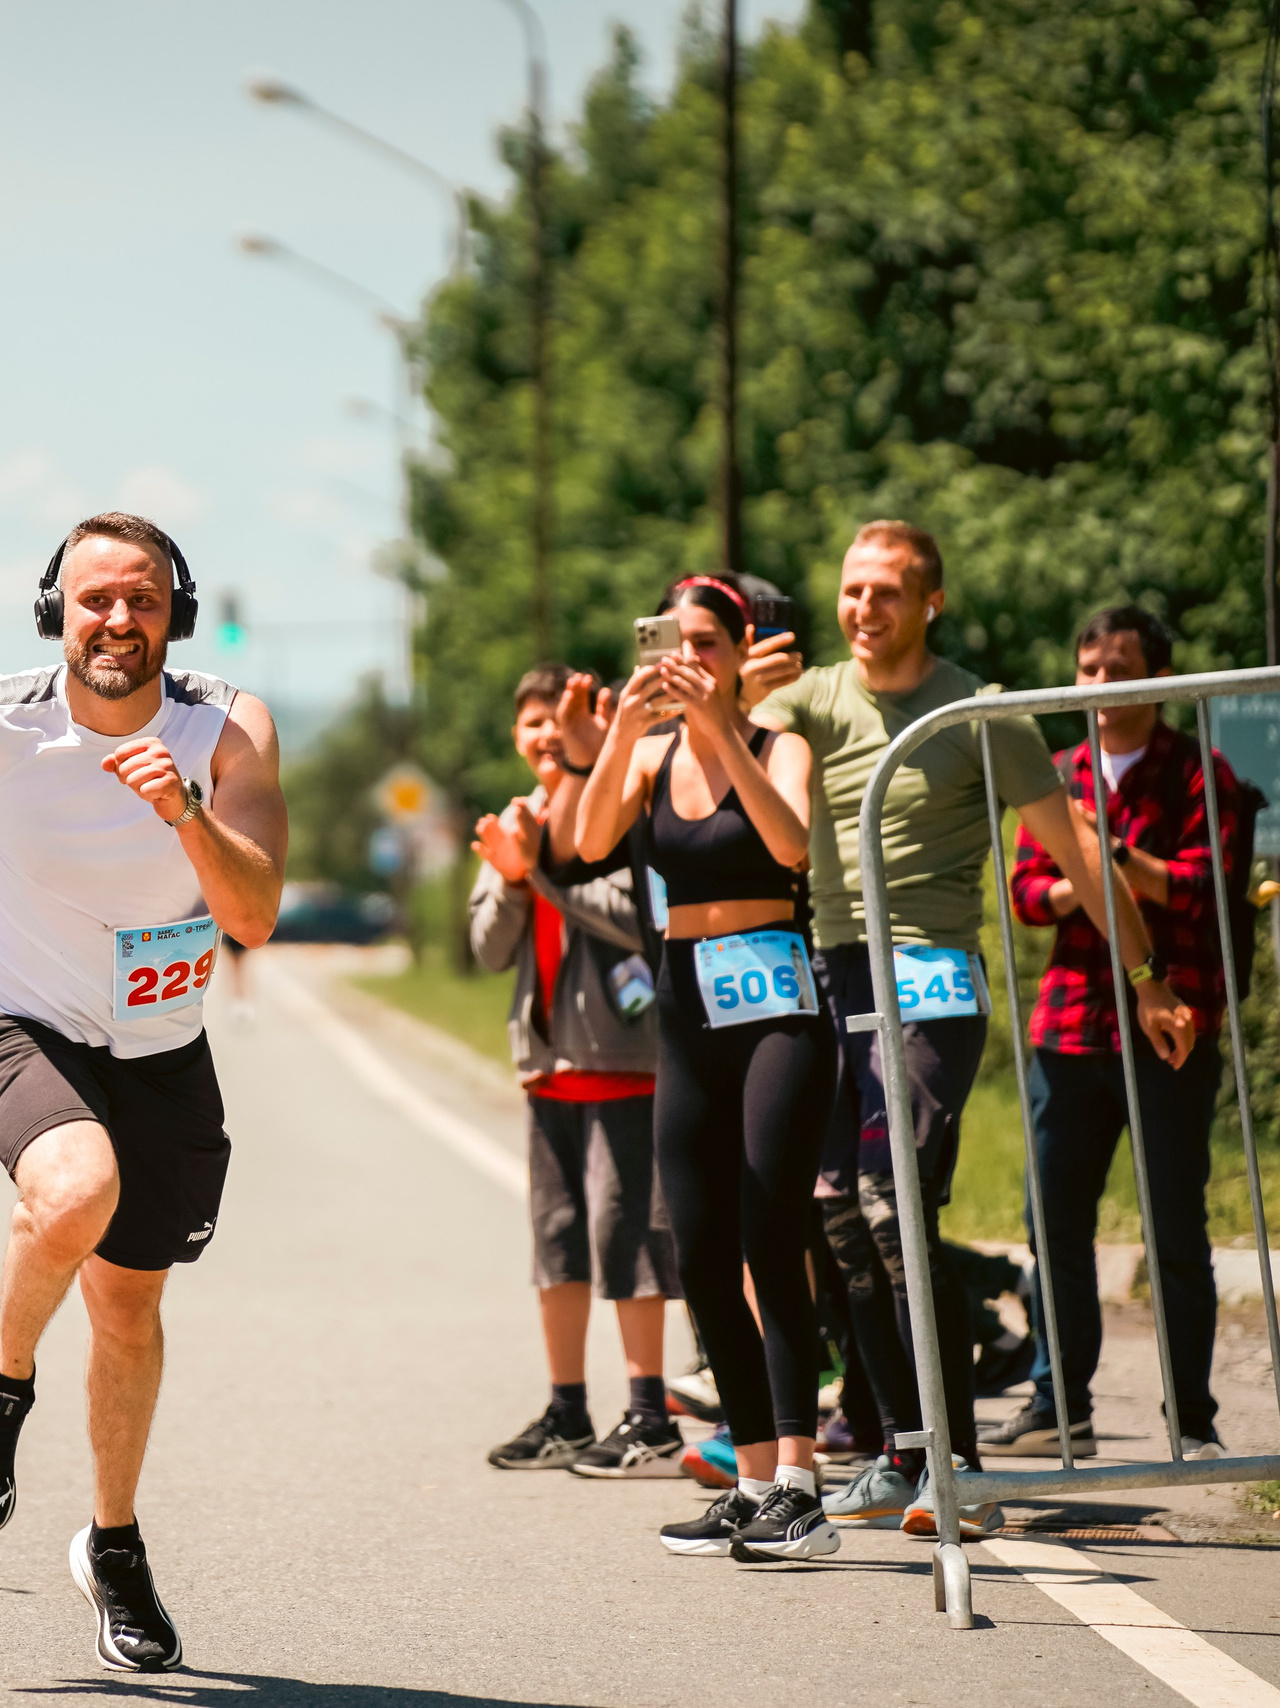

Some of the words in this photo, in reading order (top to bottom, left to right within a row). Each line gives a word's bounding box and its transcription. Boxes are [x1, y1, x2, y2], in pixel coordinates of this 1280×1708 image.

[127, 948, 213, 1007] 229
[714, 965, 799, 1009] 506
[896, 970, 975, 1008] 545
